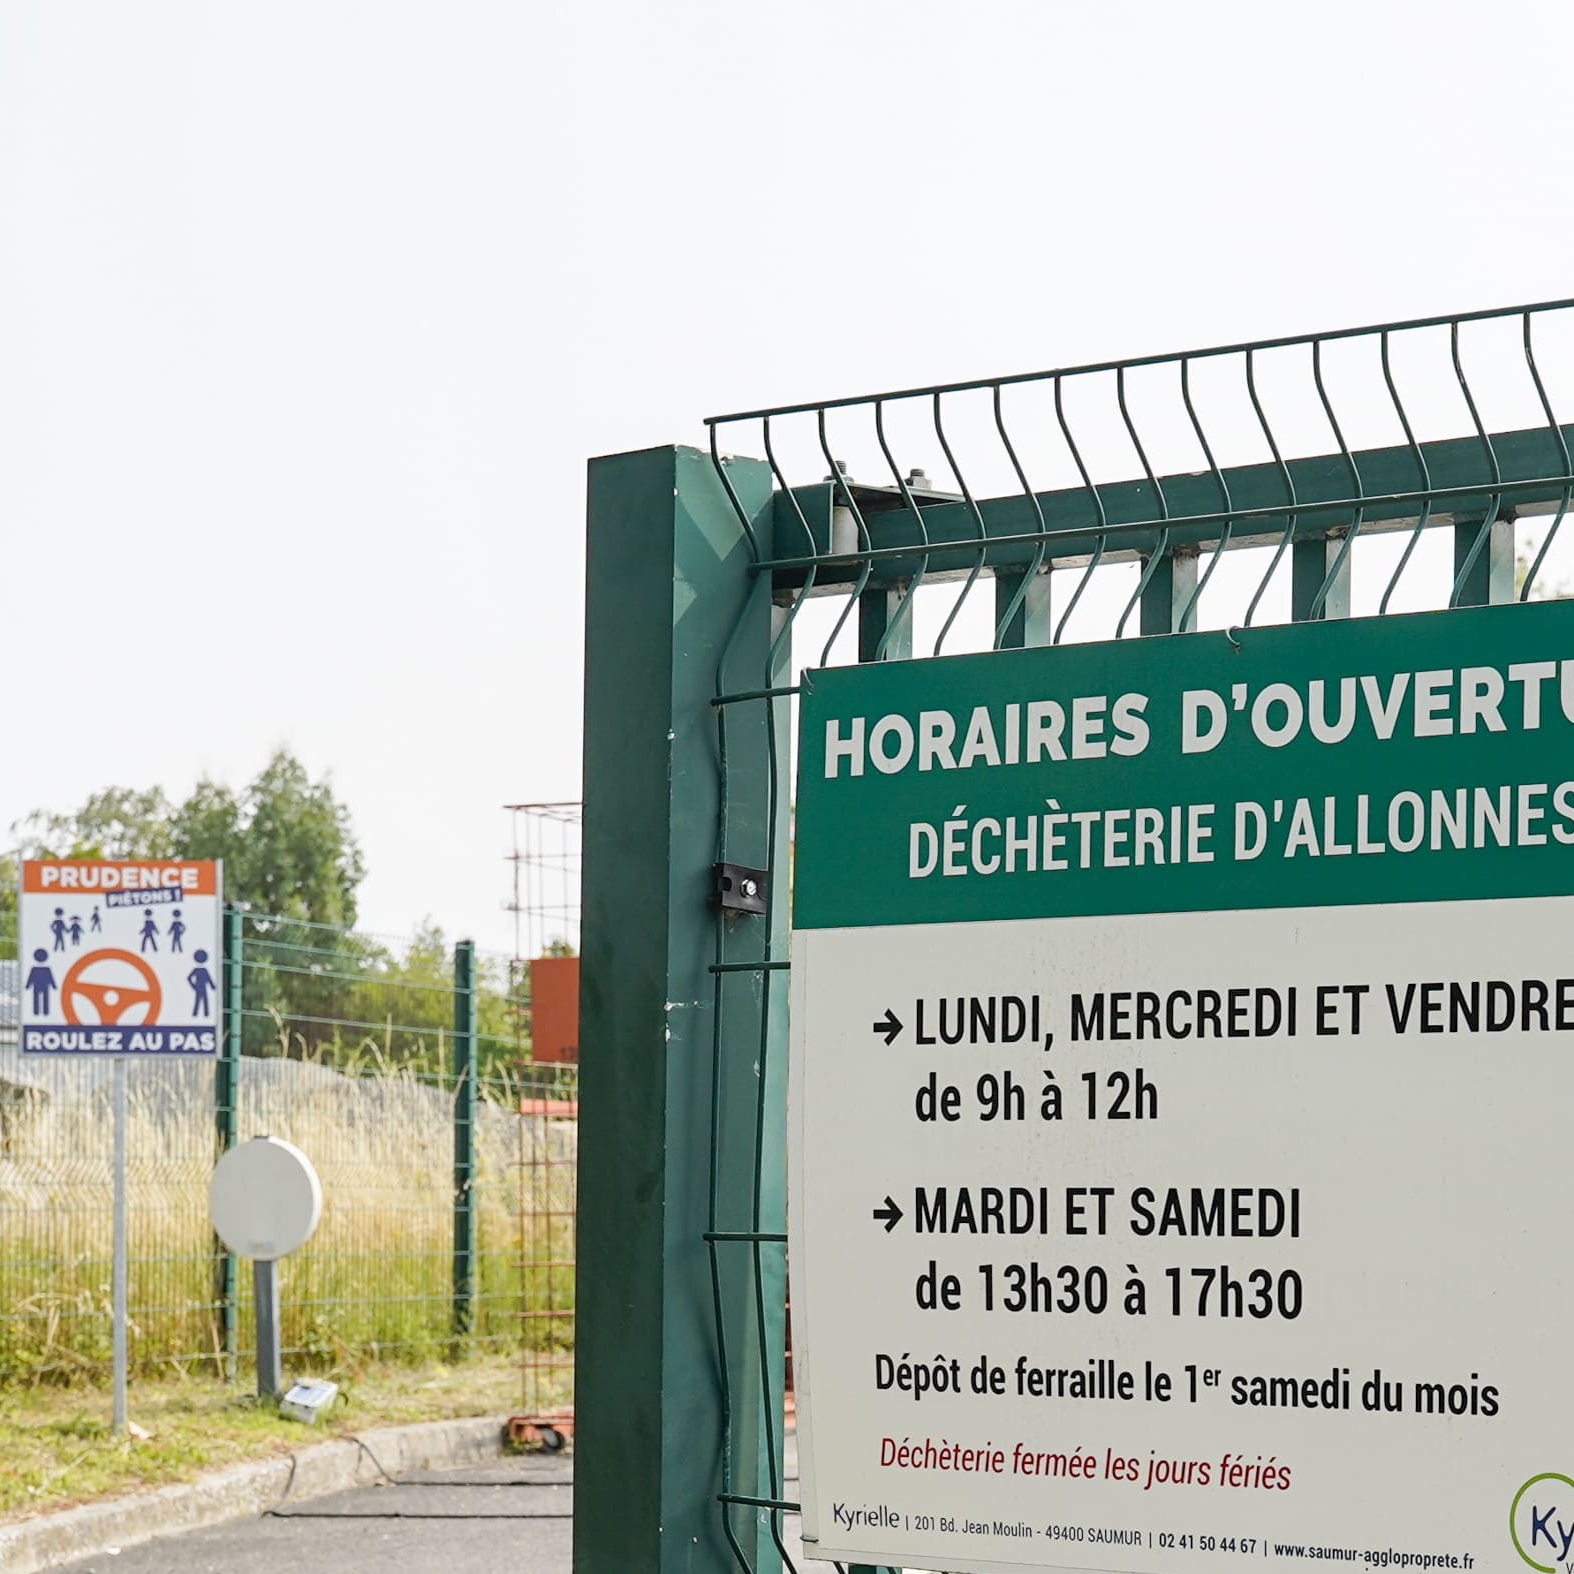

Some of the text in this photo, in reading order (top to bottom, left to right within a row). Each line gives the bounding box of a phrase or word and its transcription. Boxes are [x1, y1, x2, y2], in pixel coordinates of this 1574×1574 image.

[825, 693, 1150, 779] HORAIRES
[909, 799, 1215, 878] DÉCHÈTERIE
[41, 866, 200, 890] PRUDENCE
[26, 1032, 215, 1051] ROULEZ AU PAS
[916, 995, 1053, 1052] LUNDI,
[1071, 987, 1297, 1041] MERCREDI
[1316, 985, 1370, 1036] ET
[915, 1068, 1158, 1122] de 9h à 12h
[915, 1187, 1299, 1238] MARDI ET SAMEDI
[916, 1260, 1302, 1320] de 13h30 à 17h30
[876, 1353, 961, 1401] Dépôt
[971, 1355, 1006, 1395] de
[1015, 1356, 1134, 1401] ferraille
[1145, 1361, 1172, 1402] le
[1231, 1368, 1350, 1410] samedi
[1362, 1369, 1403, 1412] du
[1415, 1373, 1499, 1417] mois
[881, 1437, 1291, 1490] Déchèterie fermée les jours fériés
[833, 1504, 1142, 1546] Kyrielle 201 Bd. Jean Moulin 49400 SAUMUR
[1159, 1533, 1474, 1570] 02 41 50 44 67 www.saumur-aggloproprete.fr
